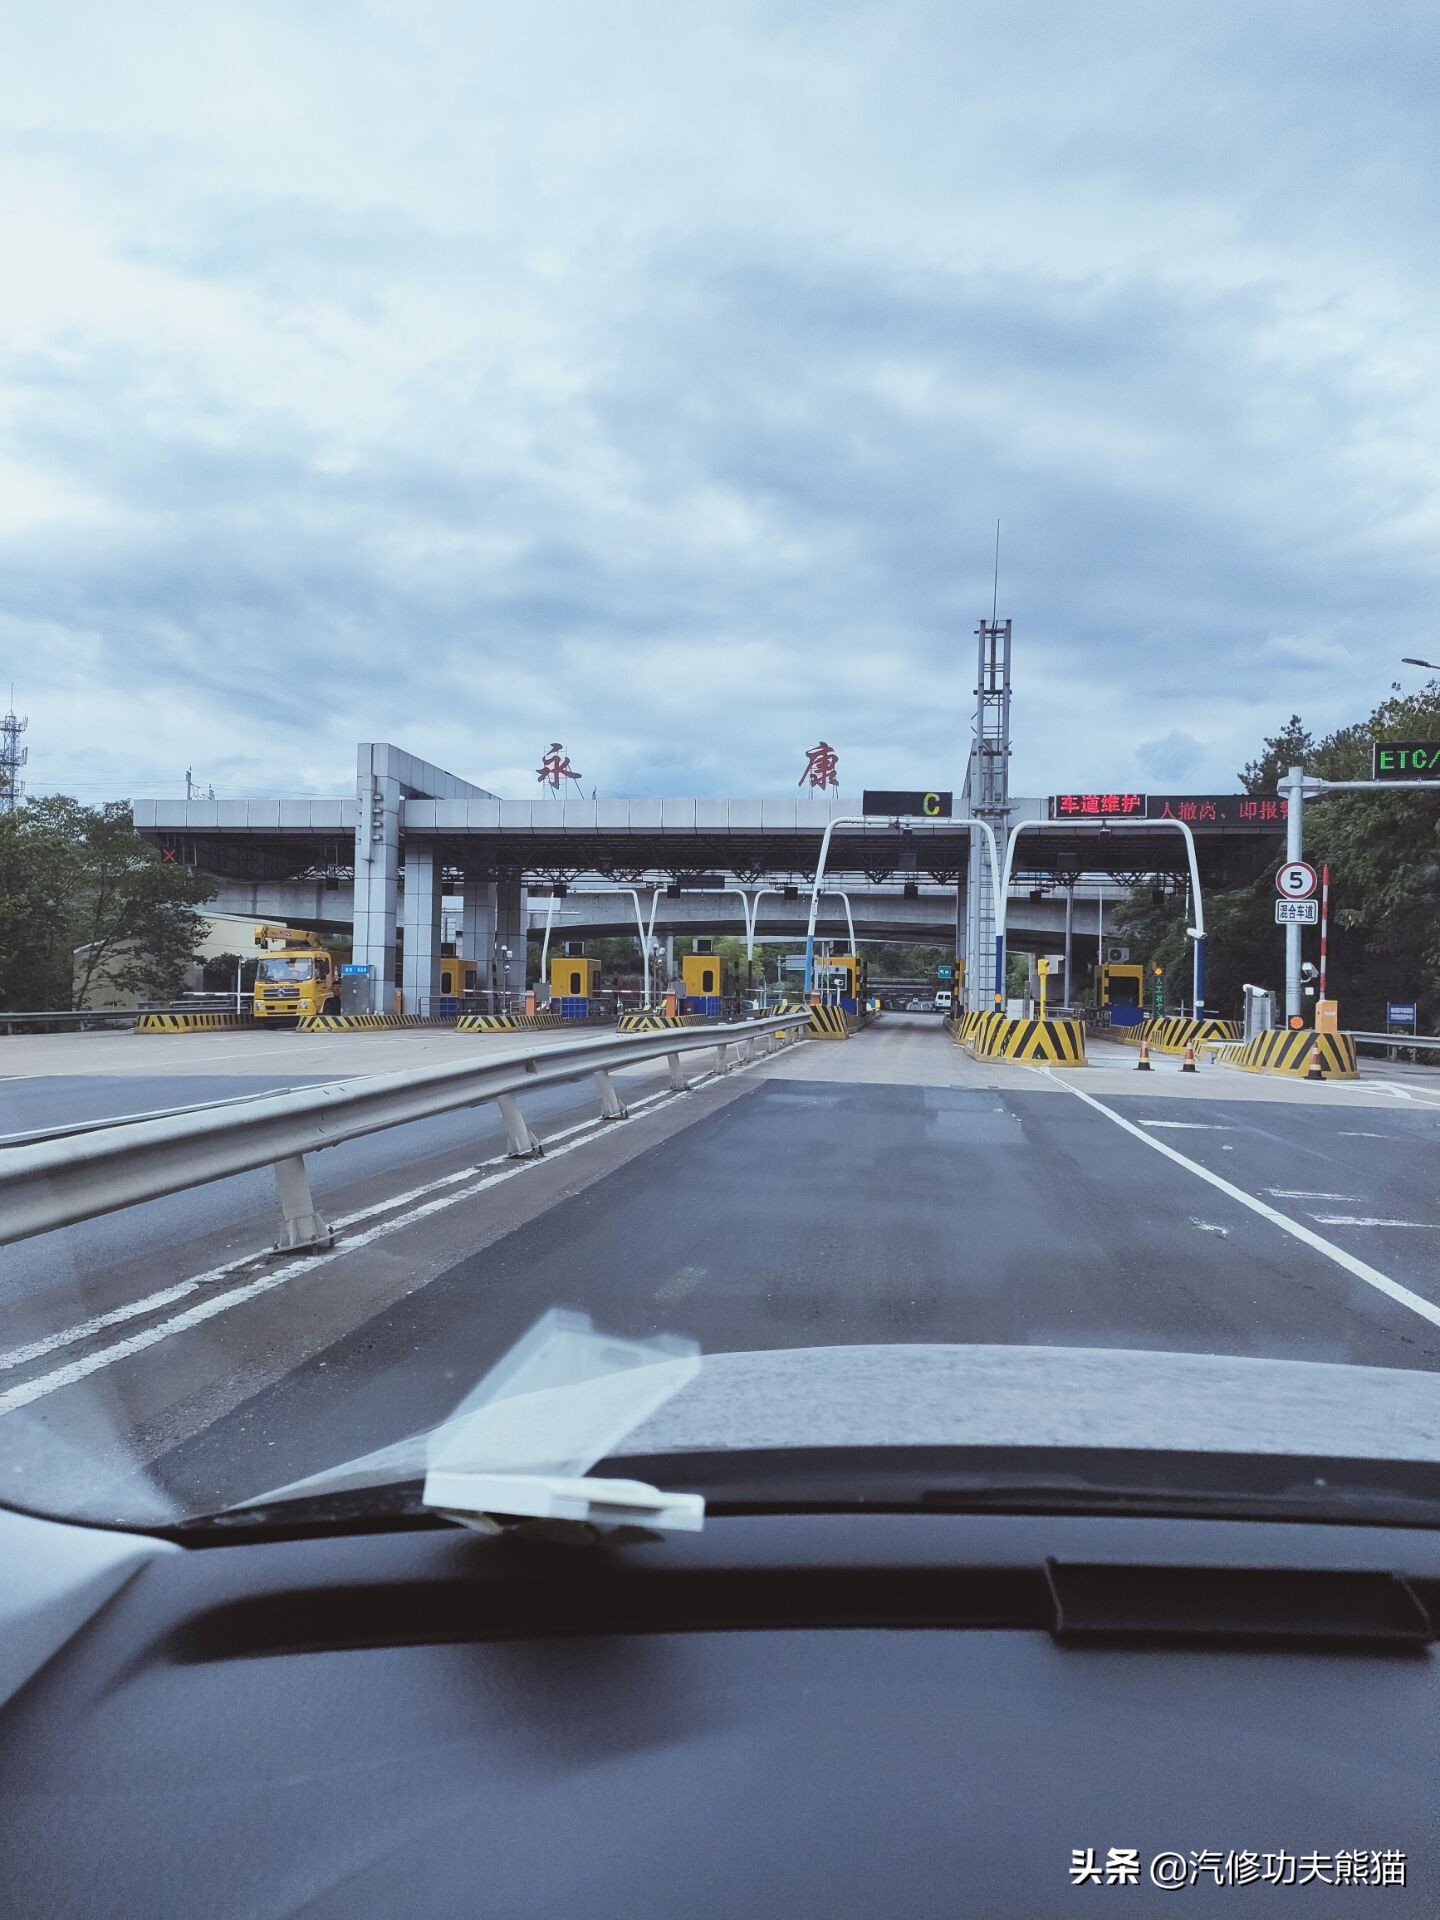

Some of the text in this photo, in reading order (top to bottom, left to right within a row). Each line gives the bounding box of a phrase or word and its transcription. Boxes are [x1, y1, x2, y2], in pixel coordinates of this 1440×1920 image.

[536, 741, 839, 791] 永 康
[1060, 793, 1140, 813] 车道维护
[1289, 872, 1303, 889] 5
[1280, 904, 1313, 919] 混合车道
